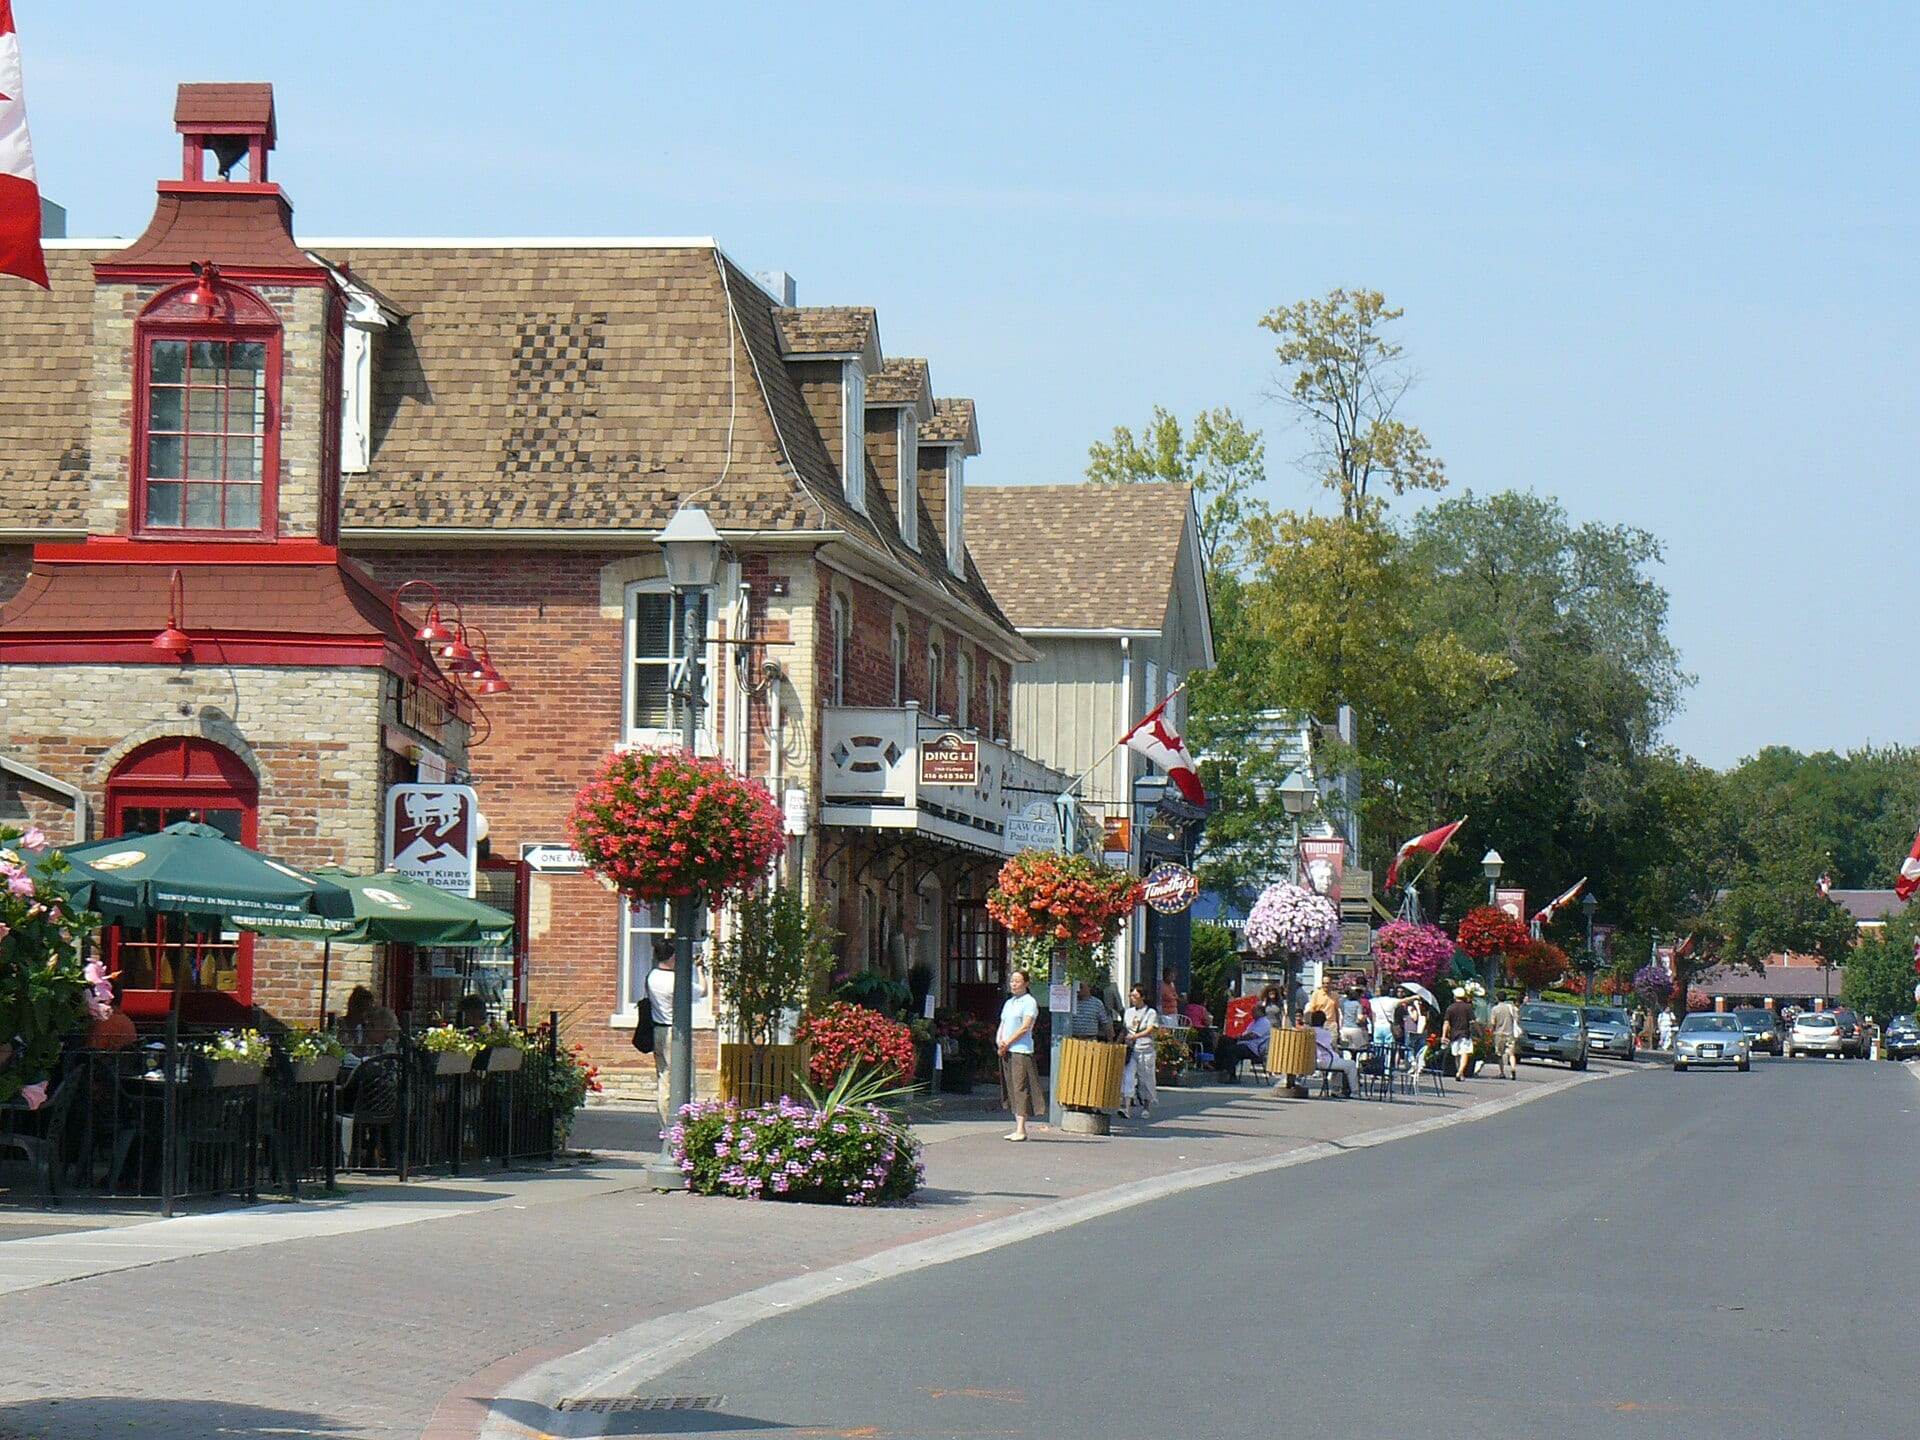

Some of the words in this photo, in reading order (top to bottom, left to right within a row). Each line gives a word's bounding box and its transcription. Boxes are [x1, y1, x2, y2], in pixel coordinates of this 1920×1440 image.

[925, 752, 959, 761] DING
[961, 752, 973, 760] LI
[1008, 821, 1030, 831] LAW
[398, 869, 431, 877] OUNT
[435, 870, 469, 878] KIRBY
[427, 878, 471, 886] BOARDS
[1142, 873, 1195, 901] Timothy's
